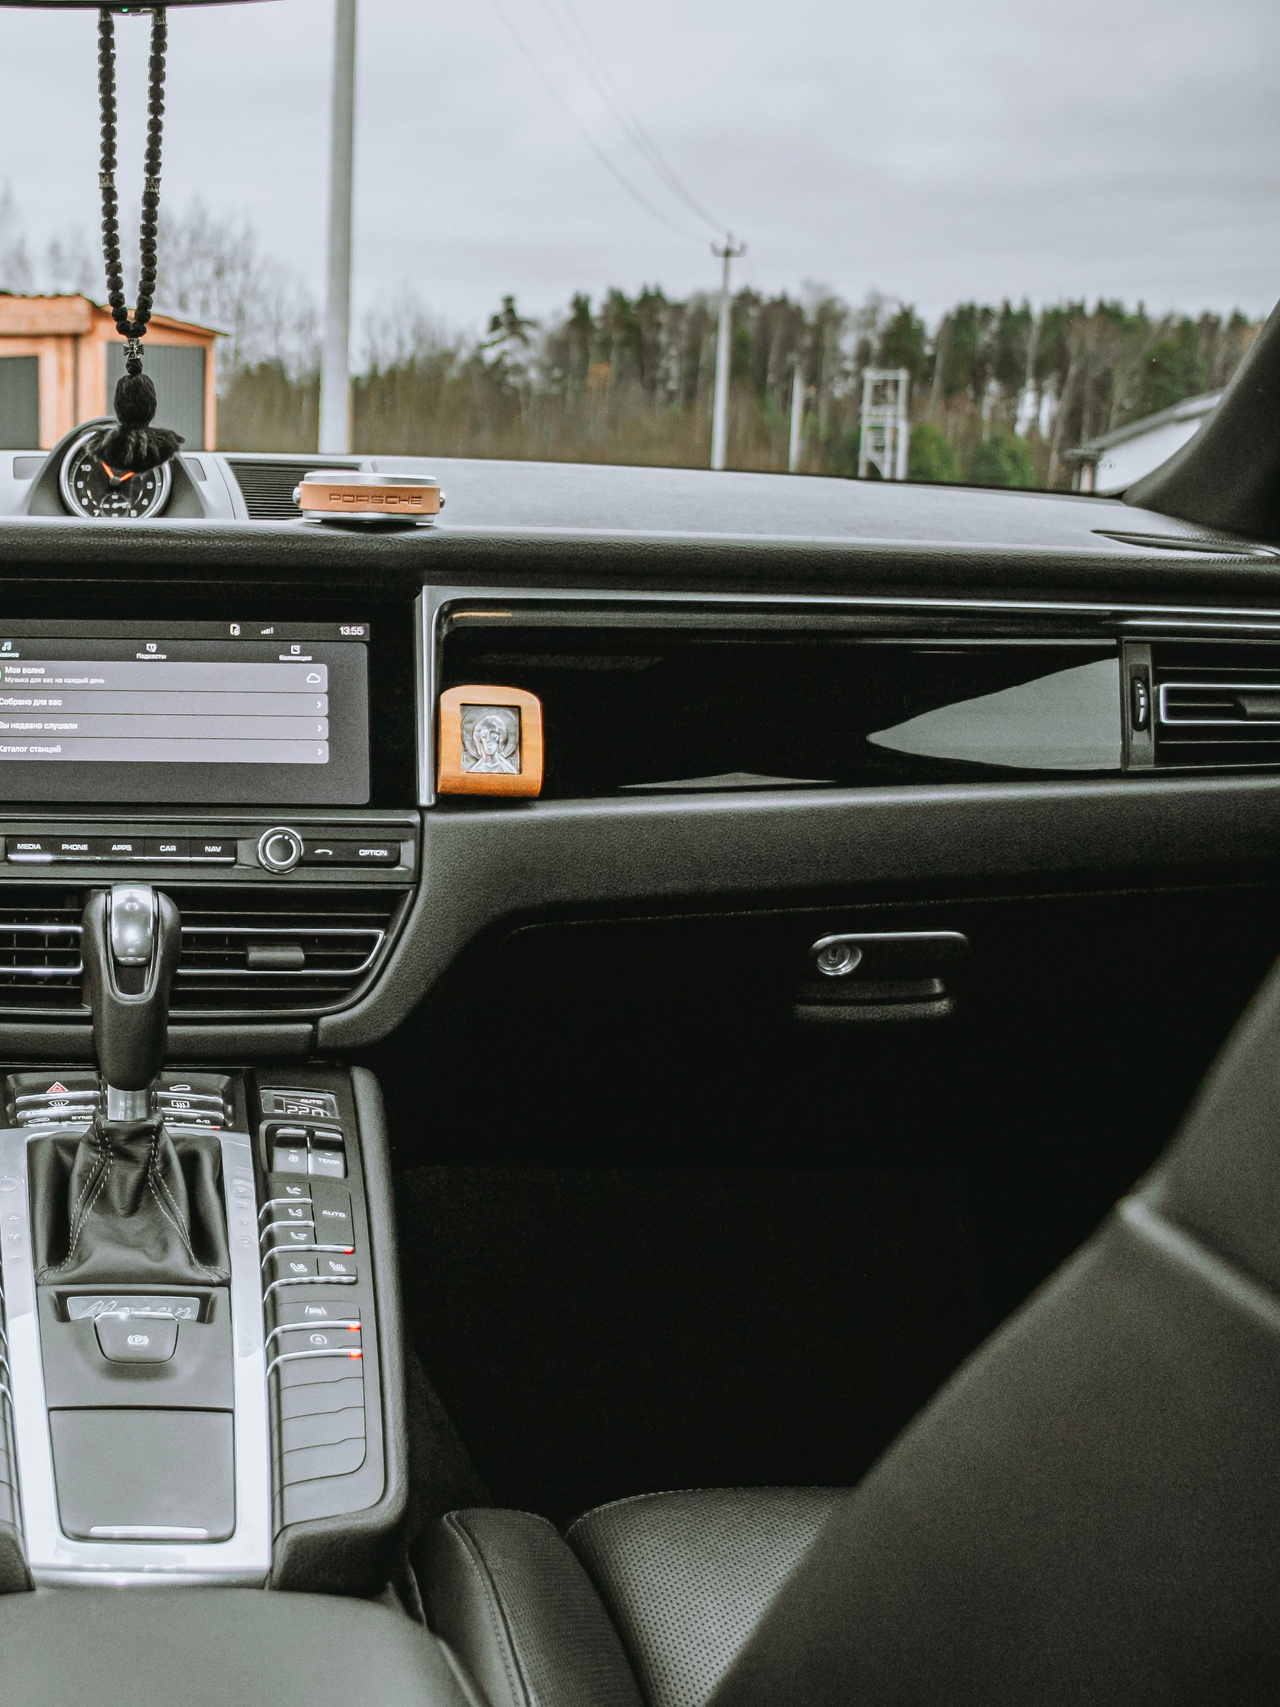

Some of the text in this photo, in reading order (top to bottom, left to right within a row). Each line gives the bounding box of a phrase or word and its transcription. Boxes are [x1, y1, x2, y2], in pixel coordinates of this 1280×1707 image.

[329, 493, 422, 505] PORSCHE
[339, 626, 365, 636] 13:55
[4, 666, 21, 674] Моя
[10, 722, 43, 730] недавно
[44, 723, 78, 731] слушали
[29, 745, 62, 753] станций
[61, 843, 88, 851] PHONE
[358, 849, 388, 857] OPTION
[322, 1209, 346, 1218] AUTO
